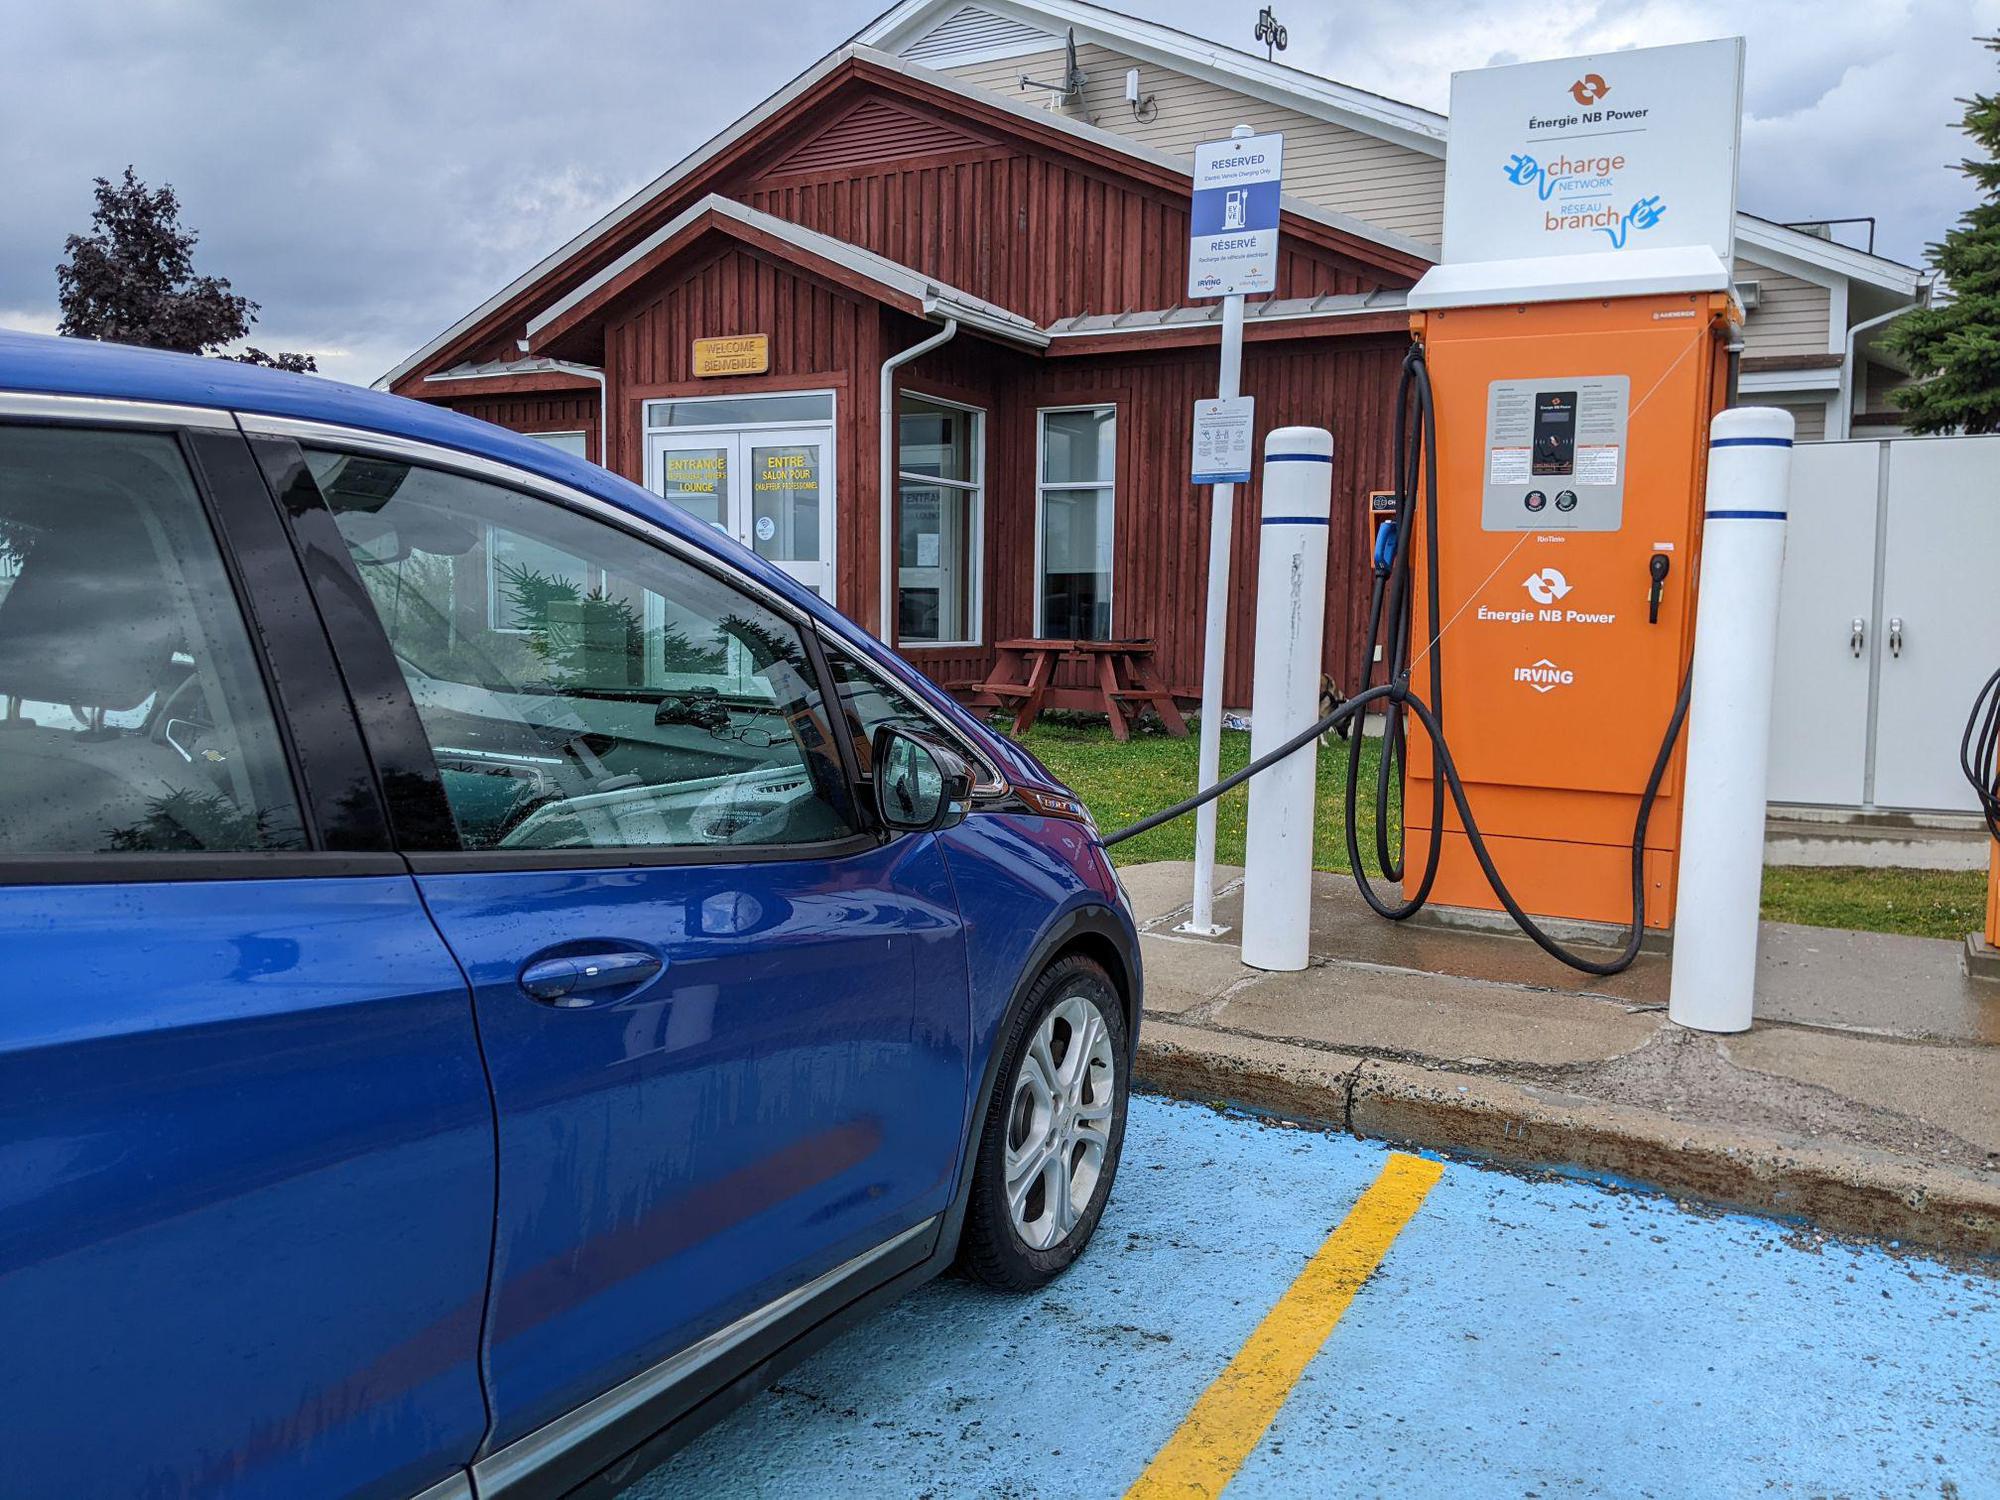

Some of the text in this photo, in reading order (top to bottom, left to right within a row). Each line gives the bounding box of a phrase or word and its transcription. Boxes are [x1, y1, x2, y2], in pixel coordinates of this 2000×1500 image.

[1529, 108, 1649, 129] Énergie NB Power
[1211, 154, 1265, 170] RESERVED
[1547, 154, 1625, 177] charge
[1260, 168, 1271, 176] Only
[1559, 177, 1614, 191] NETWORK
[1545, 205, 1619, 231] branch
[1210, 236, 1257, 252] RÉSERVÉ
[1197, 278, 1221, 287] IRVING
[705, 341, 755, 354] WELCOME
[704, 357, 757, 372] BIENVENUE
[669, 458, 726, 471] ENTRANCE
[767, 455, 805, 468] ENTRE
[762, 469, 811, 480] SALON POUR
[679, 482, 714, 492] LOUNGE
[1477, 605, 1615, 624] Énergie NB Power
[1513, 667, 1574, 684] IRVING
